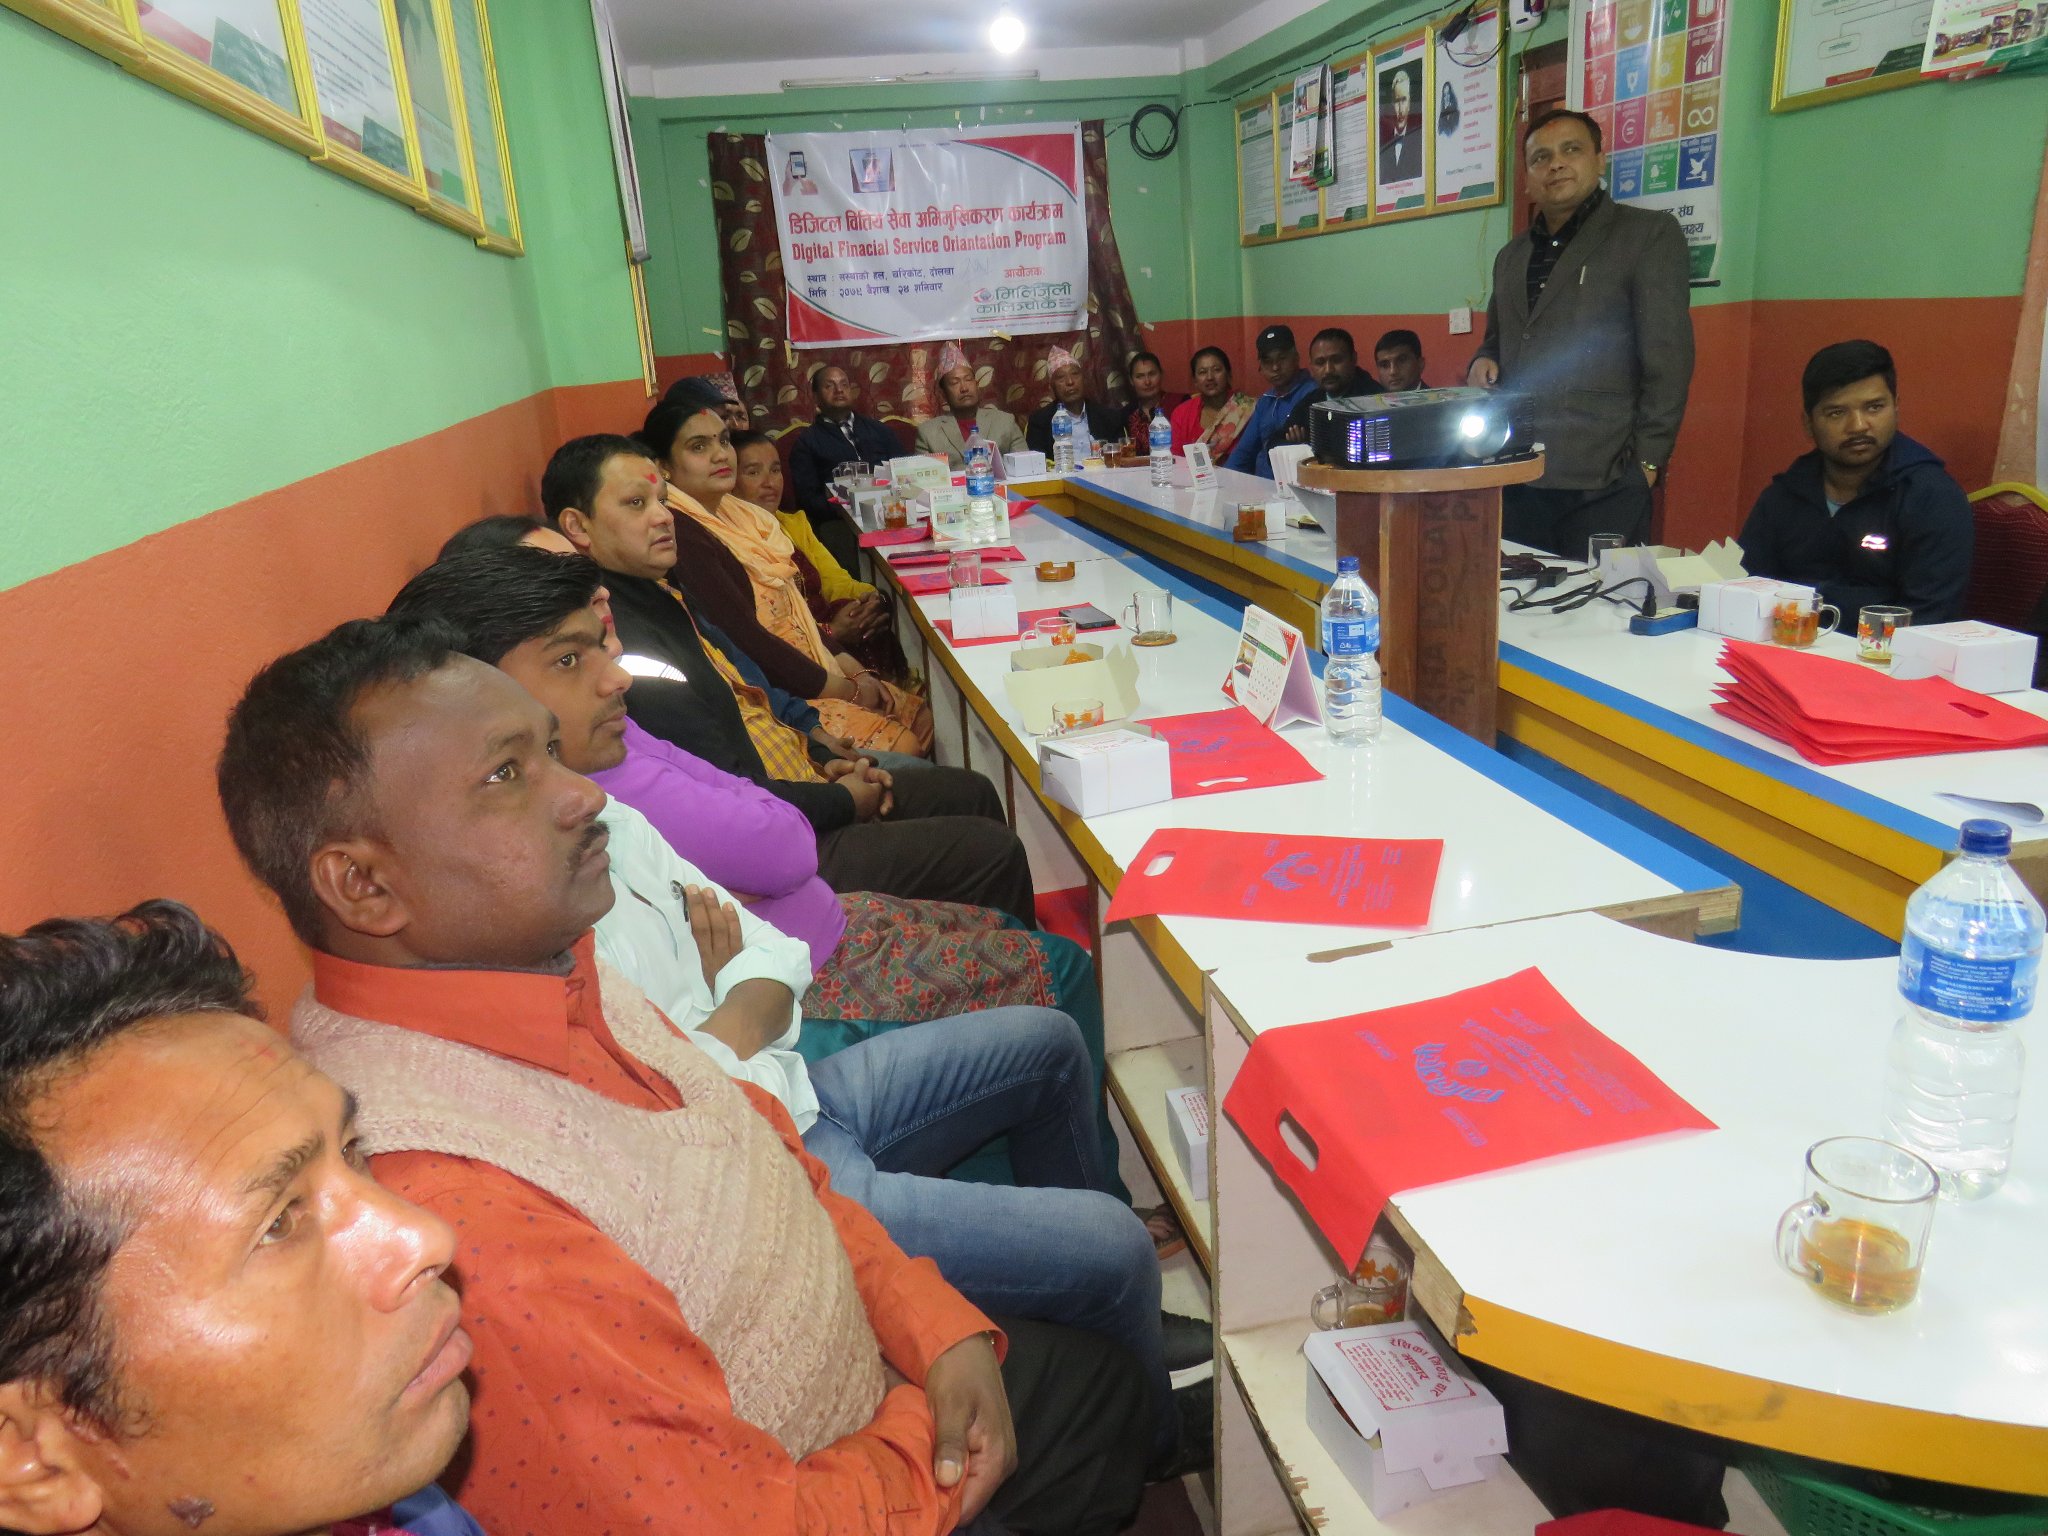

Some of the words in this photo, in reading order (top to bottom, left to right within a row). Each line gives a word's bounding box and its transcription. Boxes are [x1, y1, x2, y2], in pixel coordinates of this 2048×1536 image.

[788, 212, 842, 235] डिजिटल
[887, 207, 912, 231] सेवा
[1008, 200, 1064, 222] कार्यक्रम
[792, 240, 834, 264] Digital
[837, 239, 889, 258] Finacial
[893, 236, 939, 256] Service
[943, 232, 1011, 253] Oriantation
[1015, 230, 1067, 251] Program
[808, 287, 828, 299] मिति
